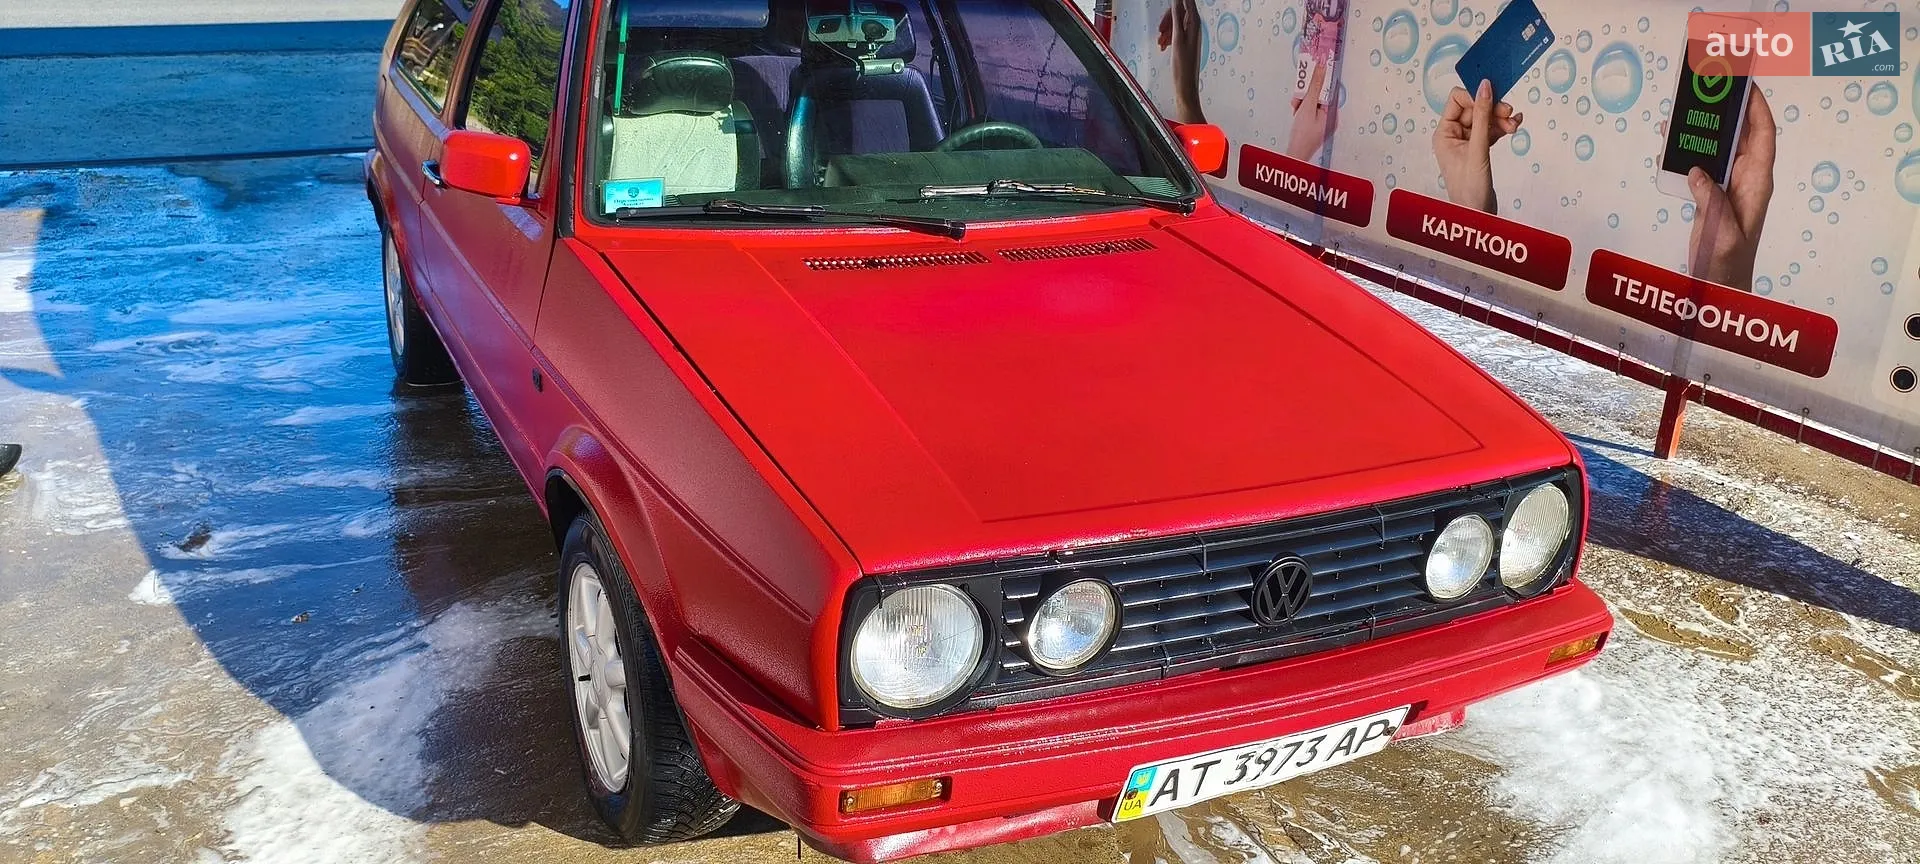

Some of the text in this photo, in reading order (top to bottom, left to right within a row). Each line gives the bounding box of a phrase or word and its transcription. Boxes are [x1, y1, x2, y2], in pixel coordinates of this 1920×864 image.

[1297, 60, 1308, 90] 200
[1686, 109, 1720, 131] ОПЛАТА
[1678, 132, 1718, 156] УСПІШНА
[1255, 162, 1348, 209] КУПЮРАМИ
[1421, 214, 1528, 263] КАРТКОЮ
[1612, 273, 1800, 353] ТЕЛЕФОНОМ
[1147, 718, 1392, 807] AT 3973 AP
[1123, 799, 1142, 812] UA
